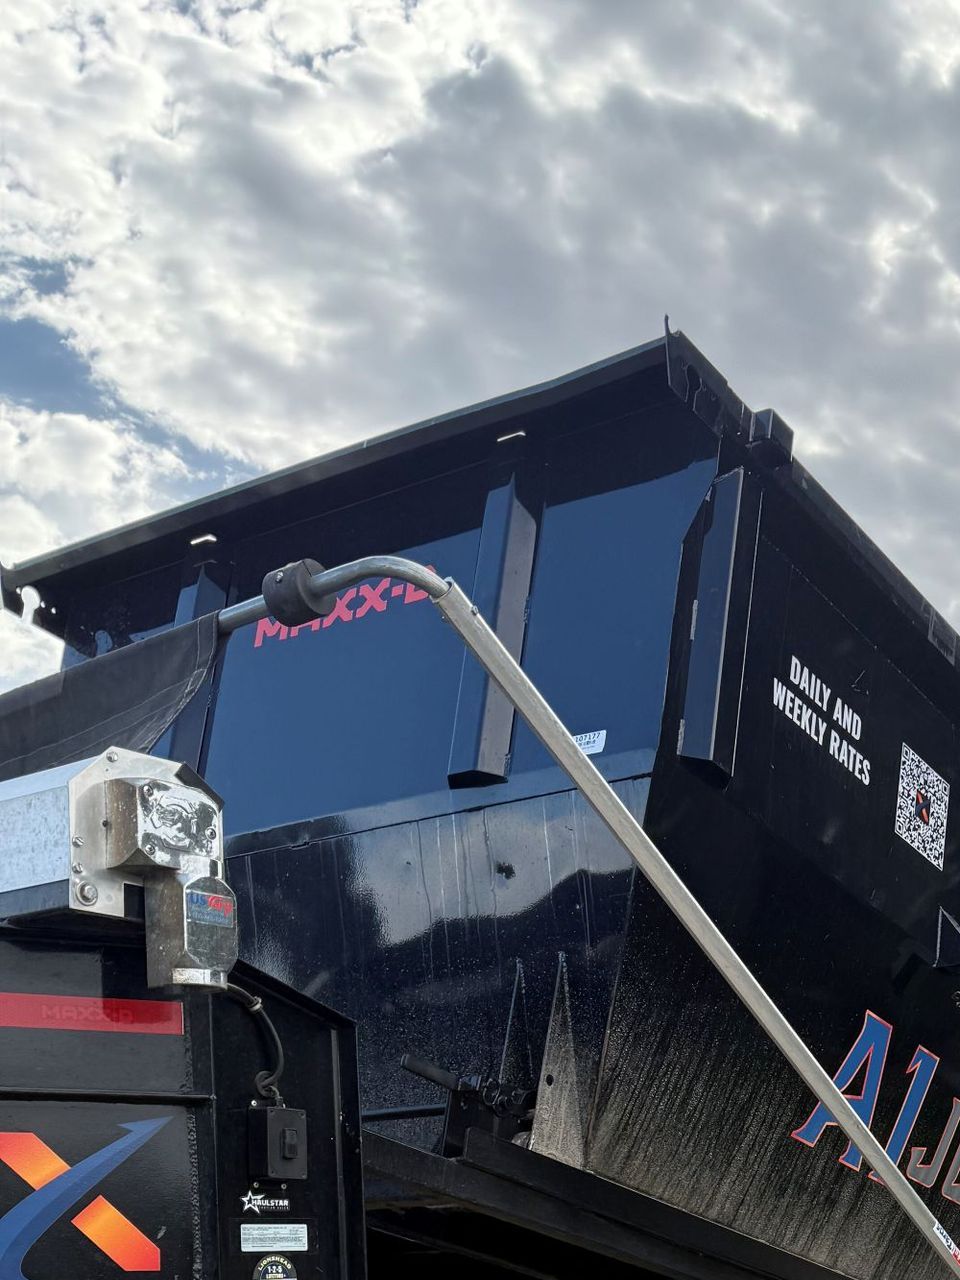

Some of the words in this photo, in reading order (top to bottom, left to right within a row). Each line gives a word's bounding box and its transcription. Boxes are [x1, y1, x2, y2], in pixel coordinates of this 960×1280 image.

[773, 677, 827, 746] WEEKLY
[829, 729, 871, 786] RATES
[790, 654, 831, 712] DAILY
[832, 697, 862, 741] AND
[790, 1009, 940, 1188] A1
[258, 1255, 292, 1271] LIONSHEAD
